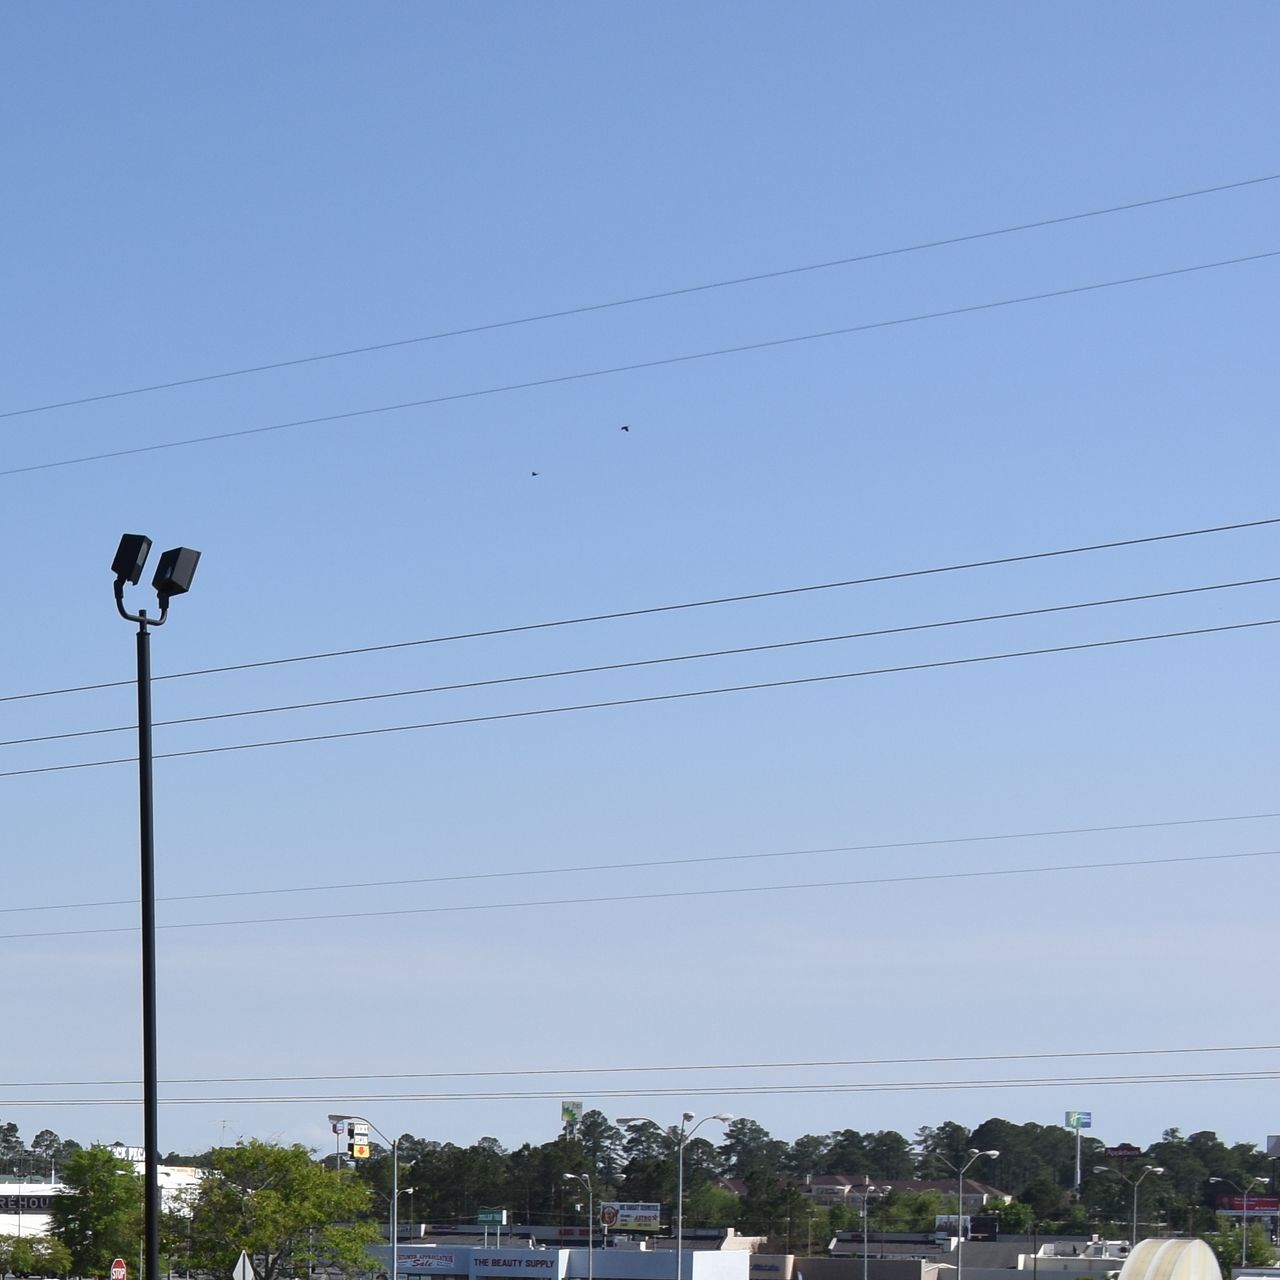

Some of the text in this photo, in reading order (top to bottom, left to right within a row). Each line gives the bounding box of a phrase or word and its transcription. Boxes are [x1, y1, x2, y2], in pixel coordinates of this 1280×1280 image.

[411, 1258, 433, 1267] Sale
[473, 1258, 555, 1268] THE BEAUTY SUPPLY
[111, 1268, 126, 1280] STOP
